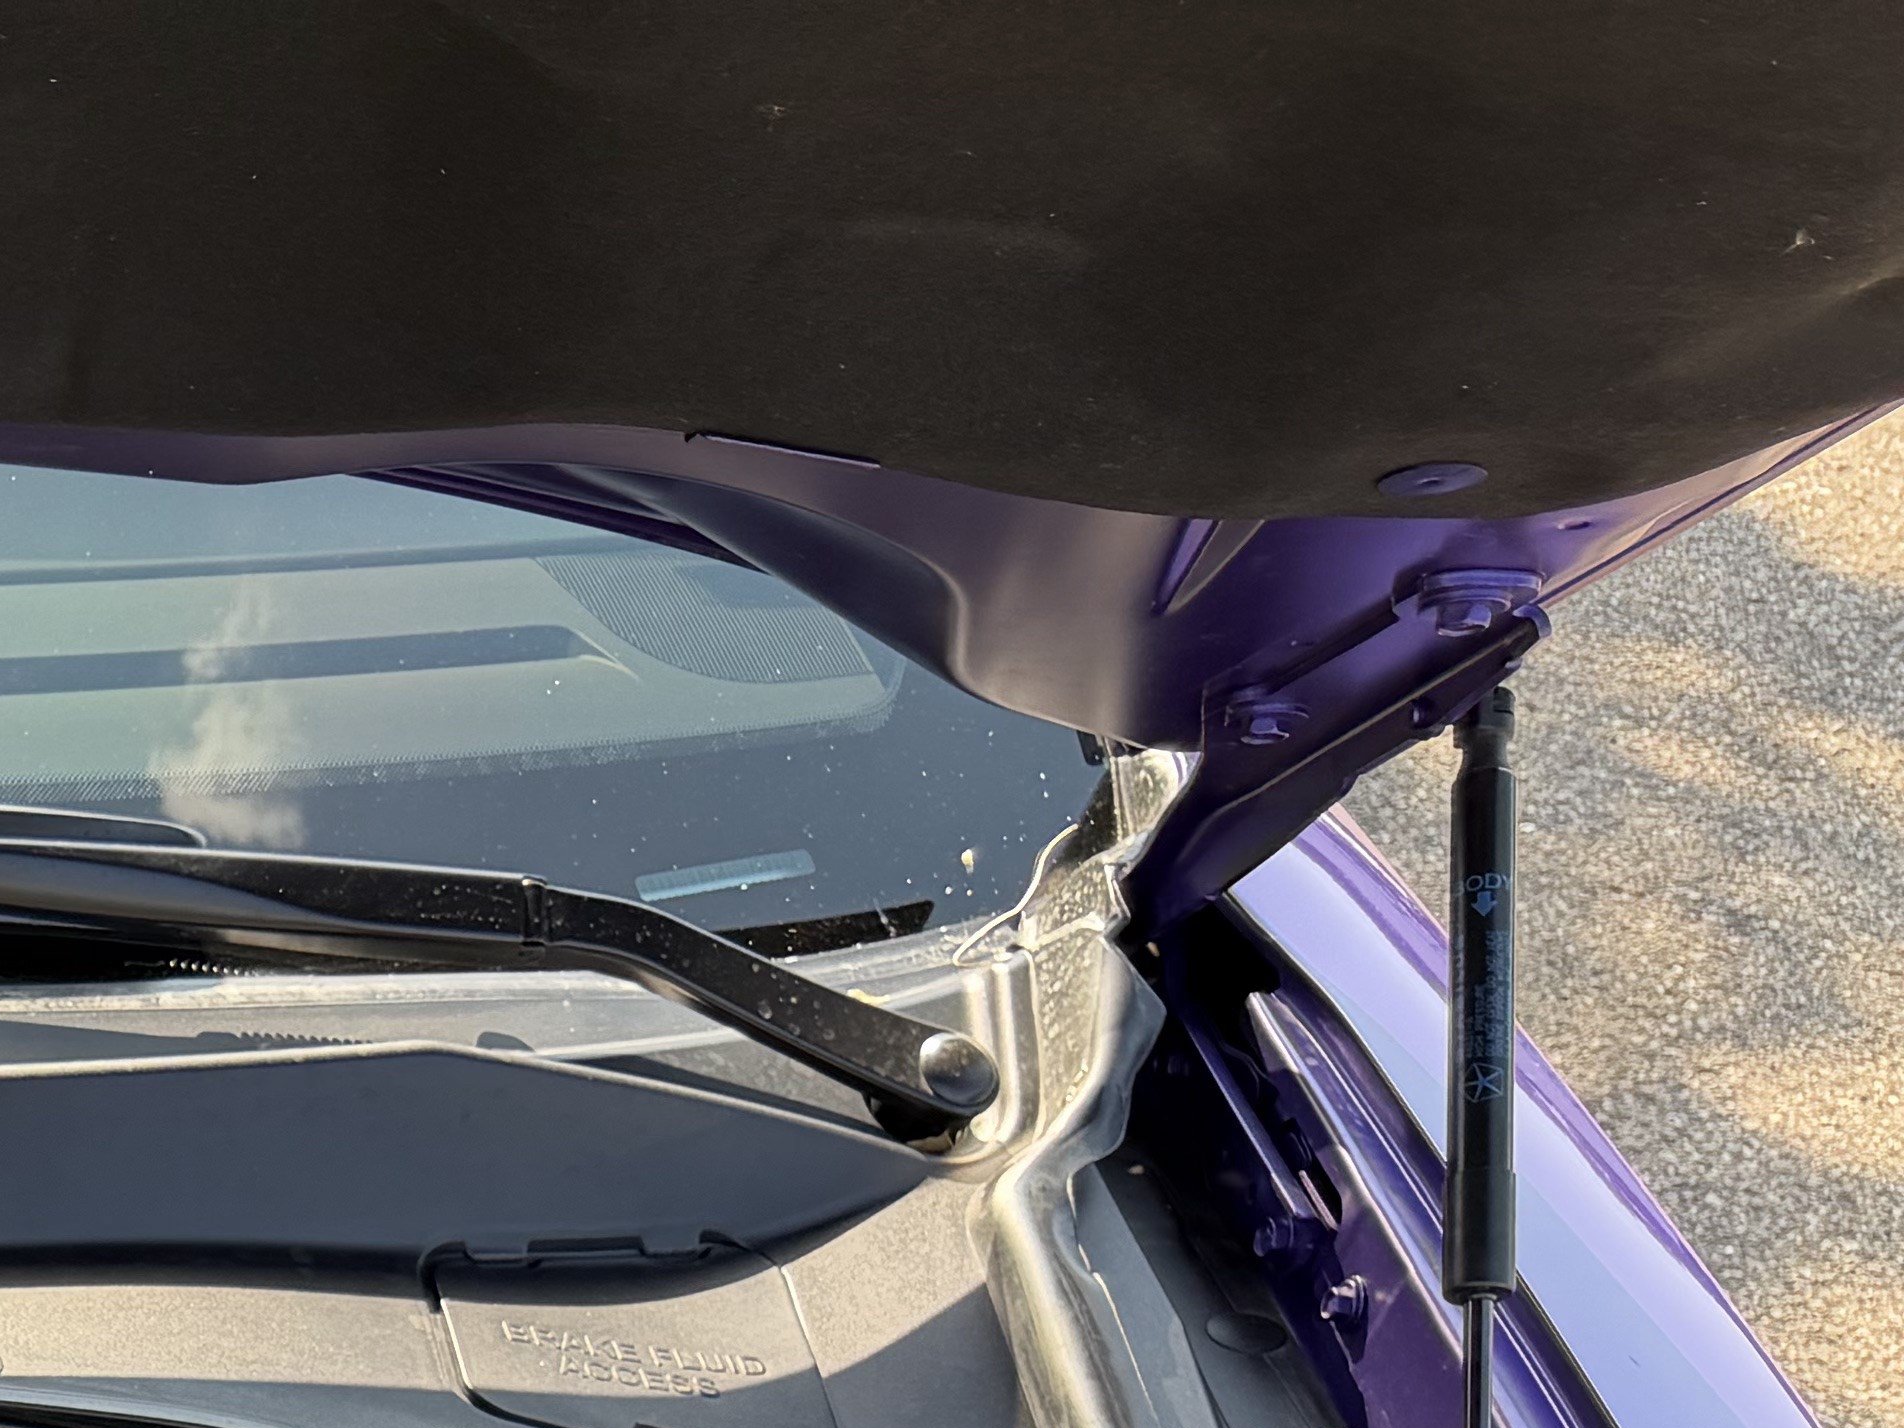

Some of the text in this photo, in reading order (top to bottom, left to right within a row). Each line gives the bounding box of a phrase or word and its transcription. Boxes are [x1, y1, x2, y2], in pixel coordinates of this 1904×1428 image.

[500, 1318, 768, 1378] BRAKE FLUID
[558, 1354, 722, 1398] ACCESS
